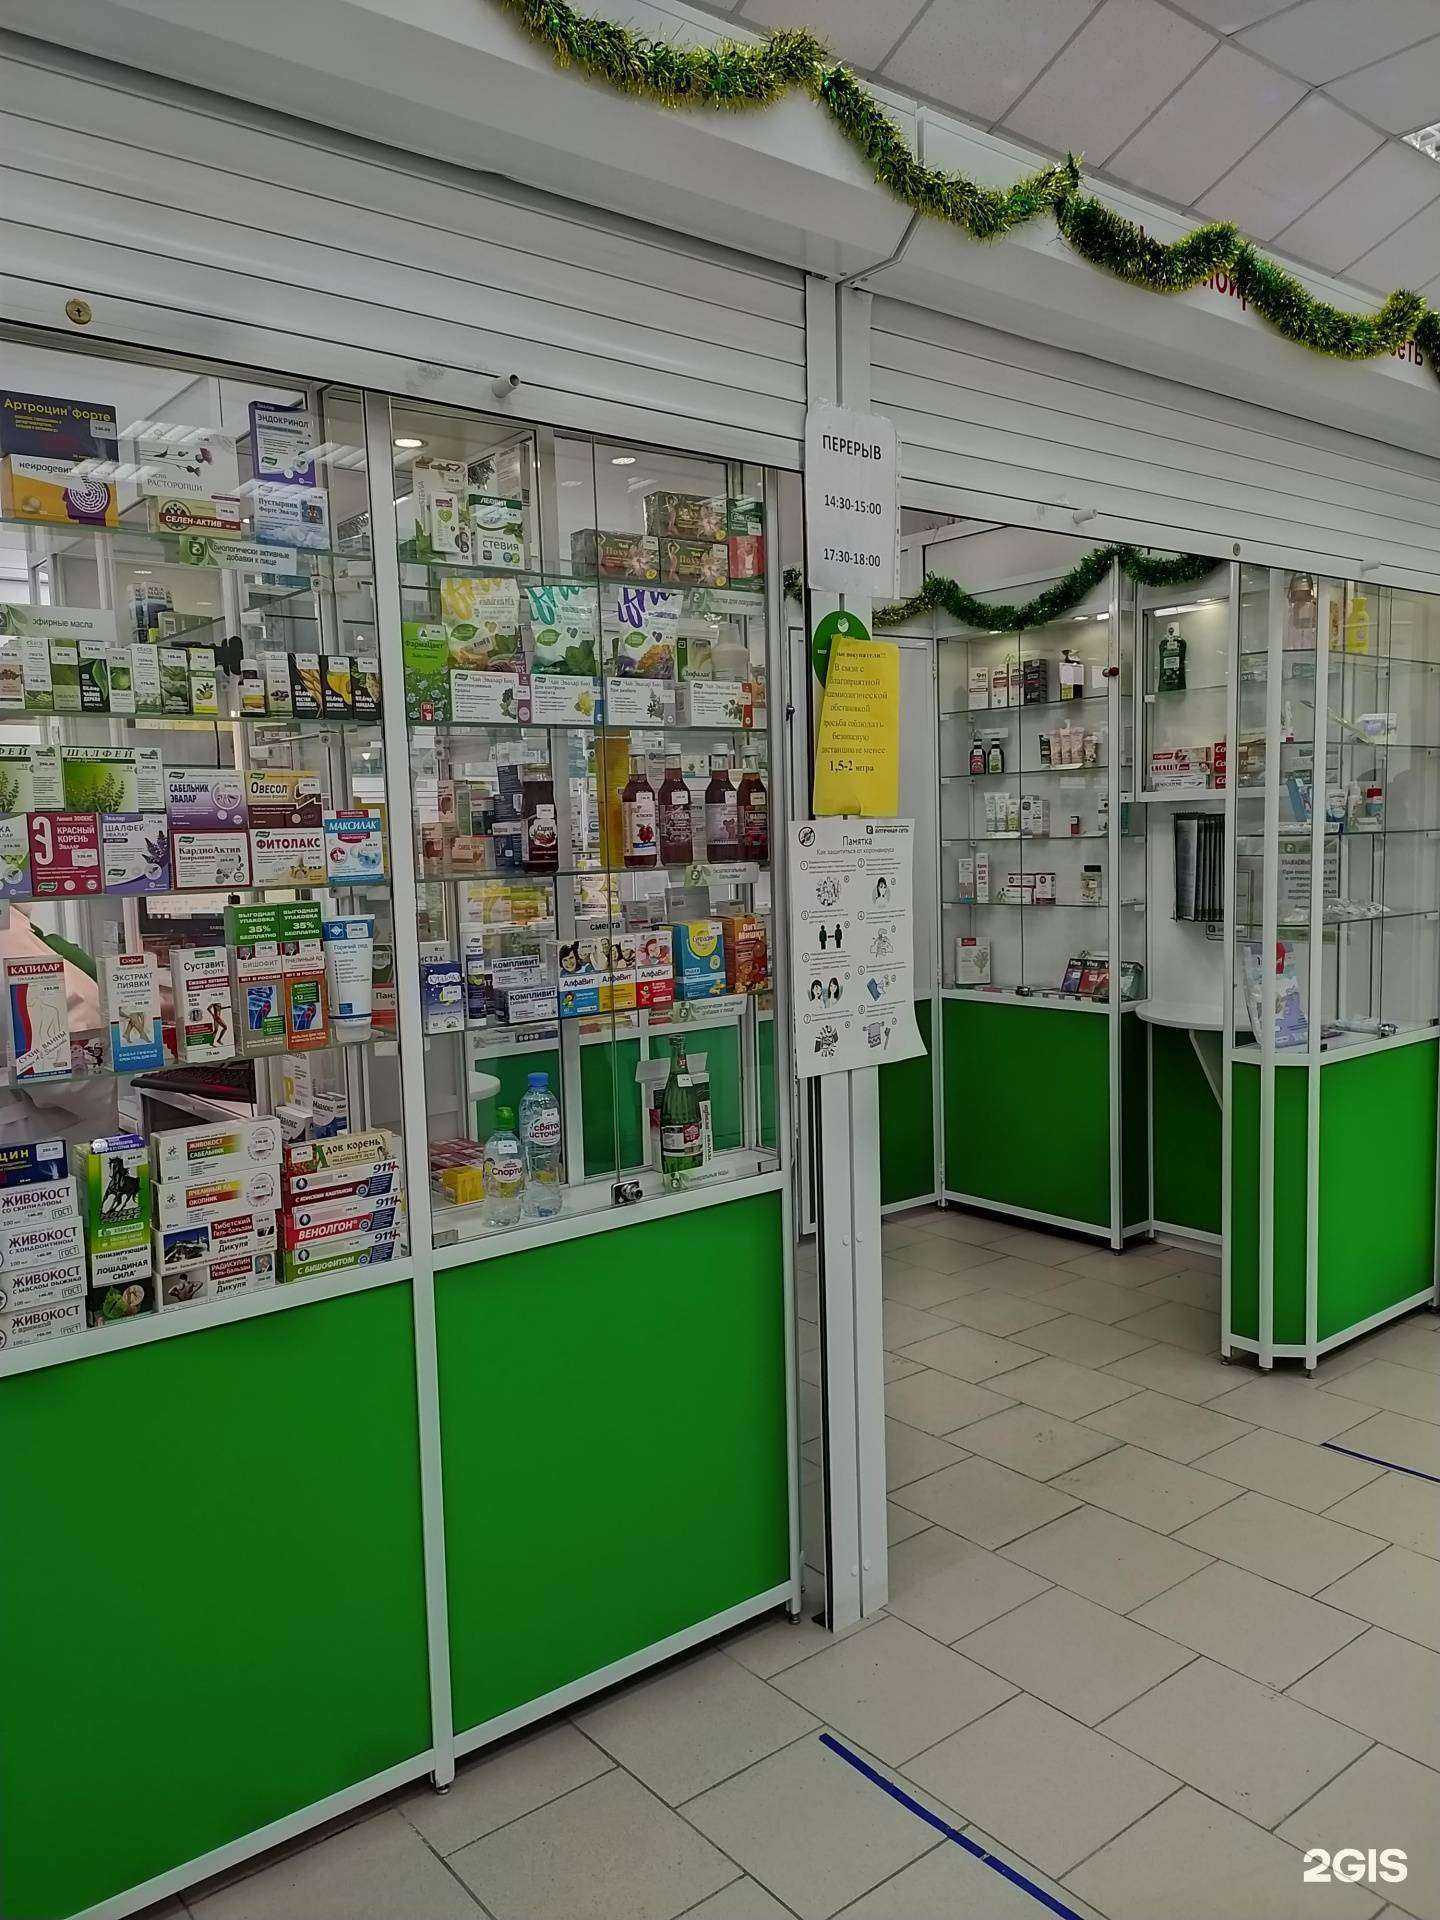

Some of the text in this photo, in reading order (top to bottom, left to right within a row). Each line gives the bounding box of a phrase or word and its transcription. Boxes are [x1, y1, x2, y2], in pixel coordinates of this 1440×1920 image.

[4, 398, 68, 416] Артроцин
[257, 412, 309, 429] ЭНДОКРИНОЛ
[822, 434, 882, 460] ПЕРЕРЫВ
[146, 477, 203, 493] РАСТОРОПШИ
[824, 494, 882, 515] 14:30-15:00
[164, 514, 222, 529] СЕЛЕН-АКТИВ
[823, 548, 881, 568] 17:30-18:00
[32, 618, 94, 629] эфирные масла
[834, 663, 840, 671] В
[67, 748, 134, 758] ШАЛФЕЙ
[829, 760, 854, 772] 1,5-2
[1151, 764, 1178, 772] LACALUT
[169, 784, 210, 793] САБЕЛЬНИК
[170, 795, 197, 803] ЭВАЛАР
[56, 825, 96, 834] КРАСНЫЙ
[104, 824, 145, 832] ШАЛФЕЙ
[328, 819, 378, 832] МАКСИЛАК
[57, 835, 89, 843] КОРЕНЬ
[255, 838, 321, 850] ФИТОЛАКС
[842, 835, 873, 847] Памятка
[179, 846, 242, 856] КардиоАктив
[238, 911, 276, 919] ВЫГОДНАЯ
[284, 913, 318, 921] УПАКОВКА
[248, 925, 272, 934] 35%
[292, 921, 315, 930] 35%
[10, 963, 60, 975] КАПИЛАР
[183, 961, 225, 972] Суставит
[242, 960, 278, 969] БИШОФИТ
[492, 958, 540, 970] КОМПЛИВИТ
[112, 972, 153, 982] ЭКСТРАКТ
[117, 980, 150, 989] ПИЯВКИ
[509, 989, 556, 1001] КОМПЛИВИТ
[189, 1138, 223, 1149] ЖИВОКОСТ
[189, 1147, 225, 1159] САБЕЛЬНИК
[2, 1186, 71, 1208] ЖИВОКОСТ
[188, 1196, 218, 1206] ОКОПНИК
[54, 1207, 70, 1218] ГОСТ
[214, 1217, 251, 1230] Тибетский
[298, 1220, 354, 1240] ВЕНОЛГОН
[8, 1226, 78, 1249] ЖИВОКОСТ
[60, 1247, 77, 1258] ГОСТ
[218, 1241, 249, 1253] Дикуля
[96, 1259, 148, 1275] ЛОШАДИНАЯ
[211, 1257, 251, 1271] РАДИКУЛИН
[12, 1265, 81, 1289] ЖИВОКОСТ
[112, 1270, 134, 1280] СИЛА
[64, 1286, 81, 1297] ГОСТ
[216, 1281, 247, 1294] Дикуля
[11, 1304, 81, 1329] ЖИВОКОСТ
[63, 1325, 79, 1336] ГОСТ
